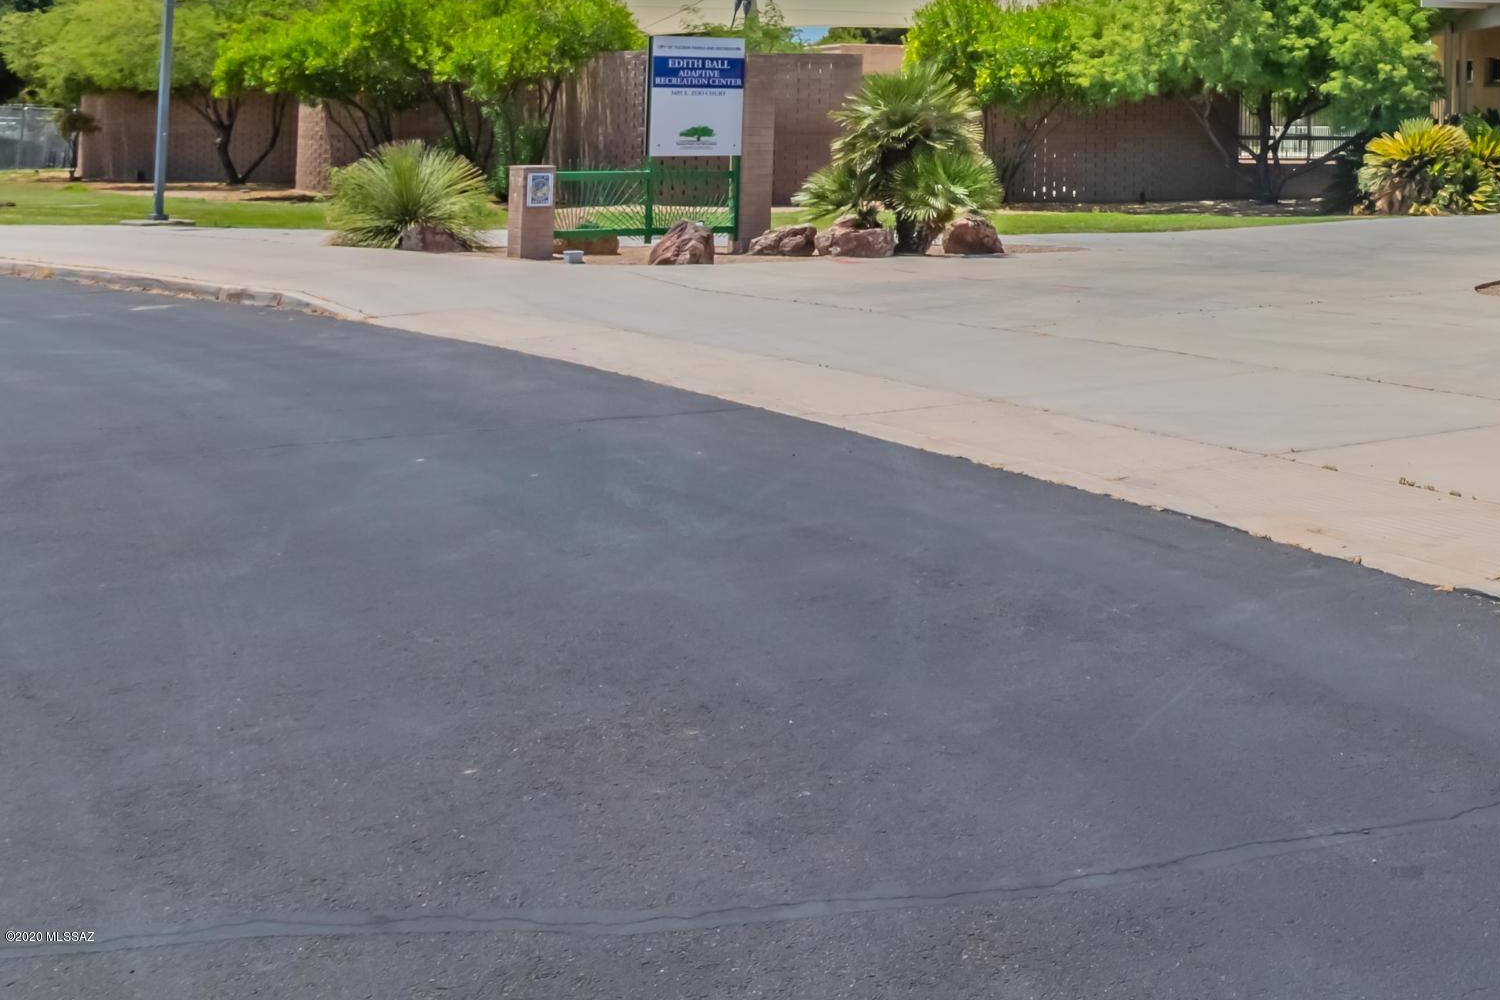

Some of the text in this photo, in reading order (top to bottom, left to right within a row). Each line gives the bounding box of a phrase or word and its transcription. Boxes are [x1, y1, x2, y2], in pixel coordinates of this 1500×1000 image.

[668, 58, 731, 69] EDITH BALL
[678, 69, 720, 77] ADAPTIVE
[655, 77, 742, 86] RECREATION CENTER
